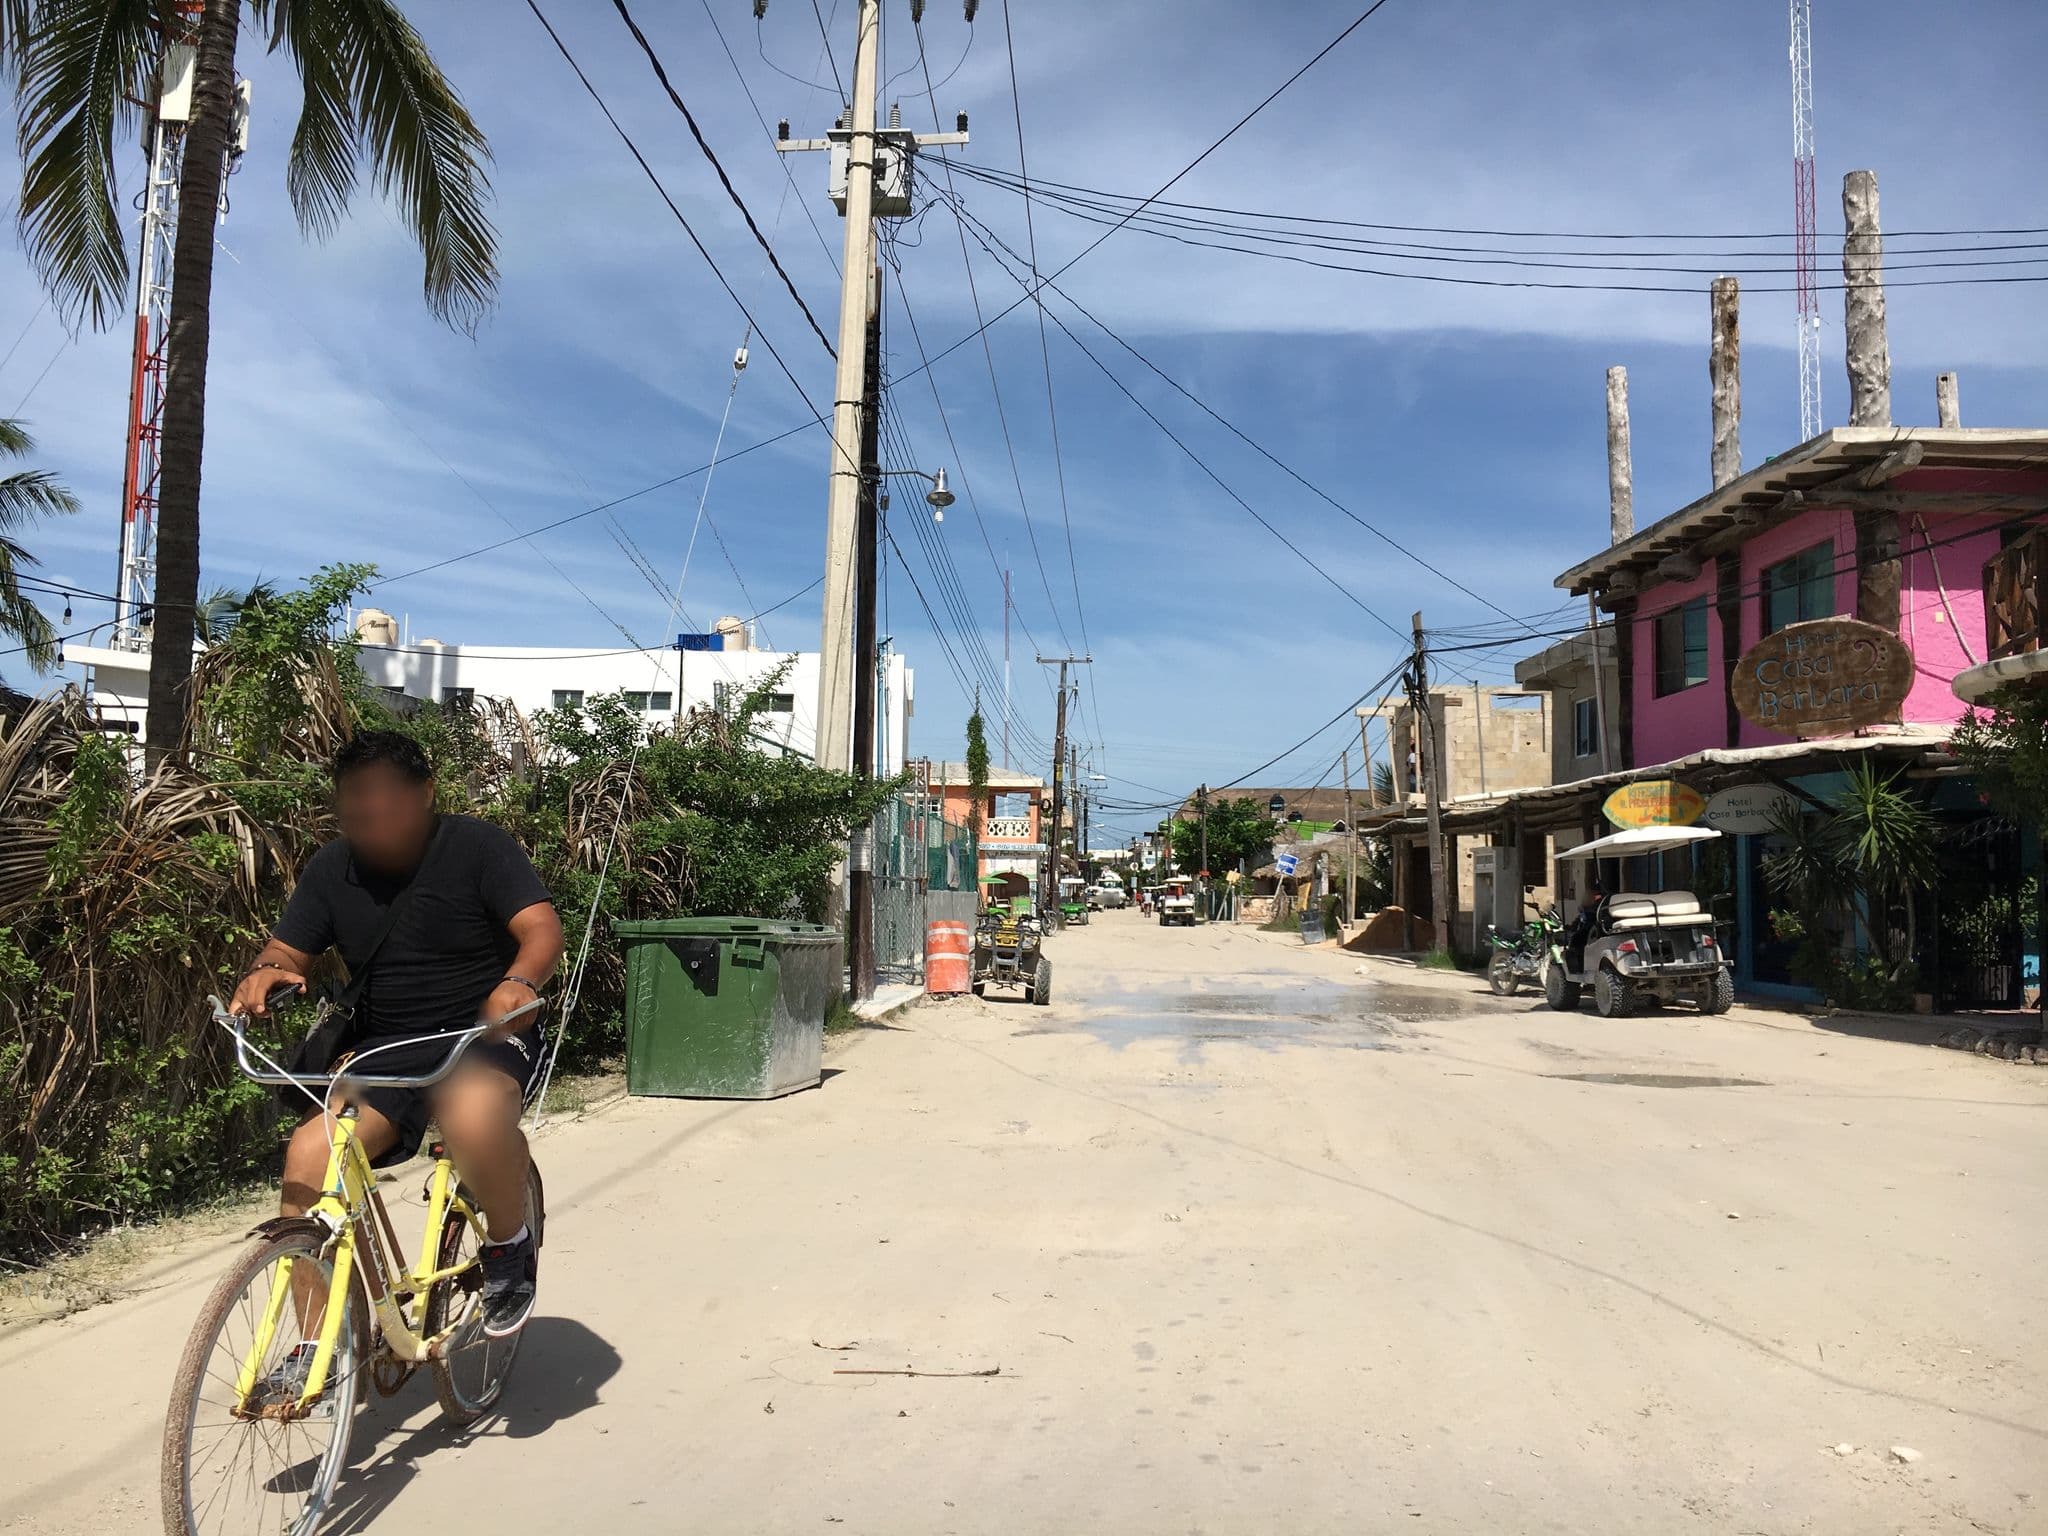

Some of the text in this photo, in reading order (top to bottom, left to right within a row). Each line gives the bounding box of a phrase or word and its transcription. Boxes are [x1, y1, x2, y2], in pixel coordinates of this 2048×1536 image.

[1784, 627, 1841, 655] Hotel
[1756, 655, 1833, 687] Casa
[1727, 798, 1753, 807] Hotel
[1708, 810, 1731, 820] Casa
